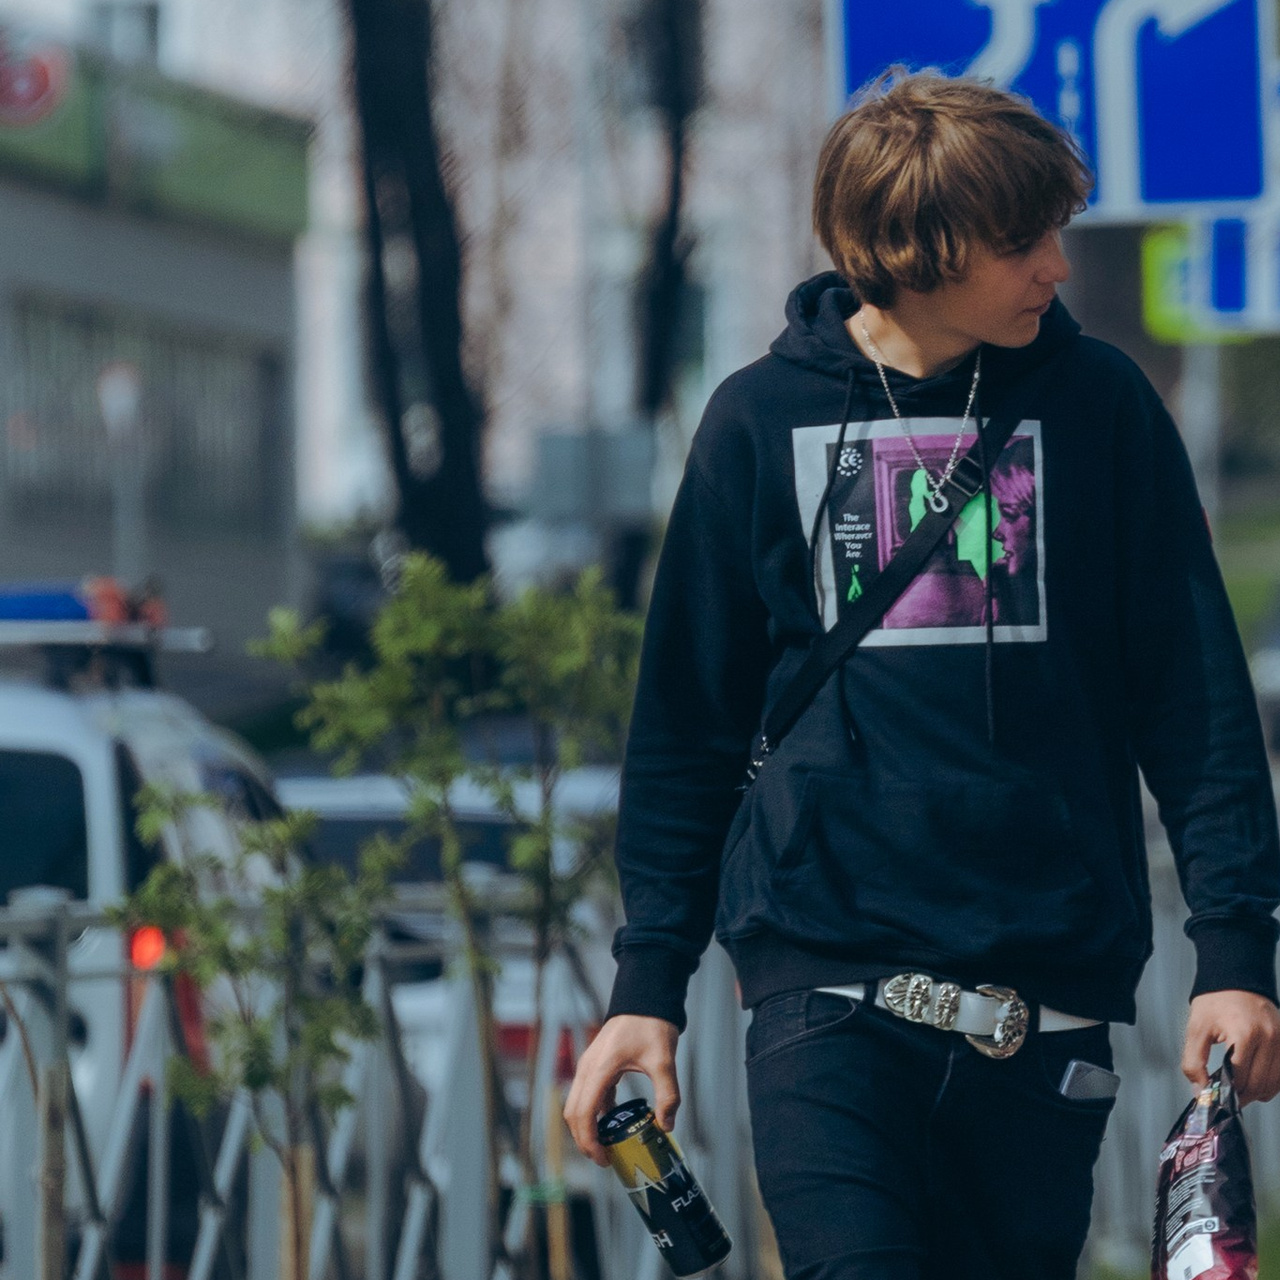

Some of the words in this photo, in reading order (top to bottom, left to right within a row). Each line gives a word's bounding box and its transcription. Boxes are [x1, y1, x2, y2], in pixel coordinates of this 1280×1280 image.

[843, 513, 860, 522] The
[844, 541, 863, 550] You
[671, 1183, 700, 1213] FLAS
